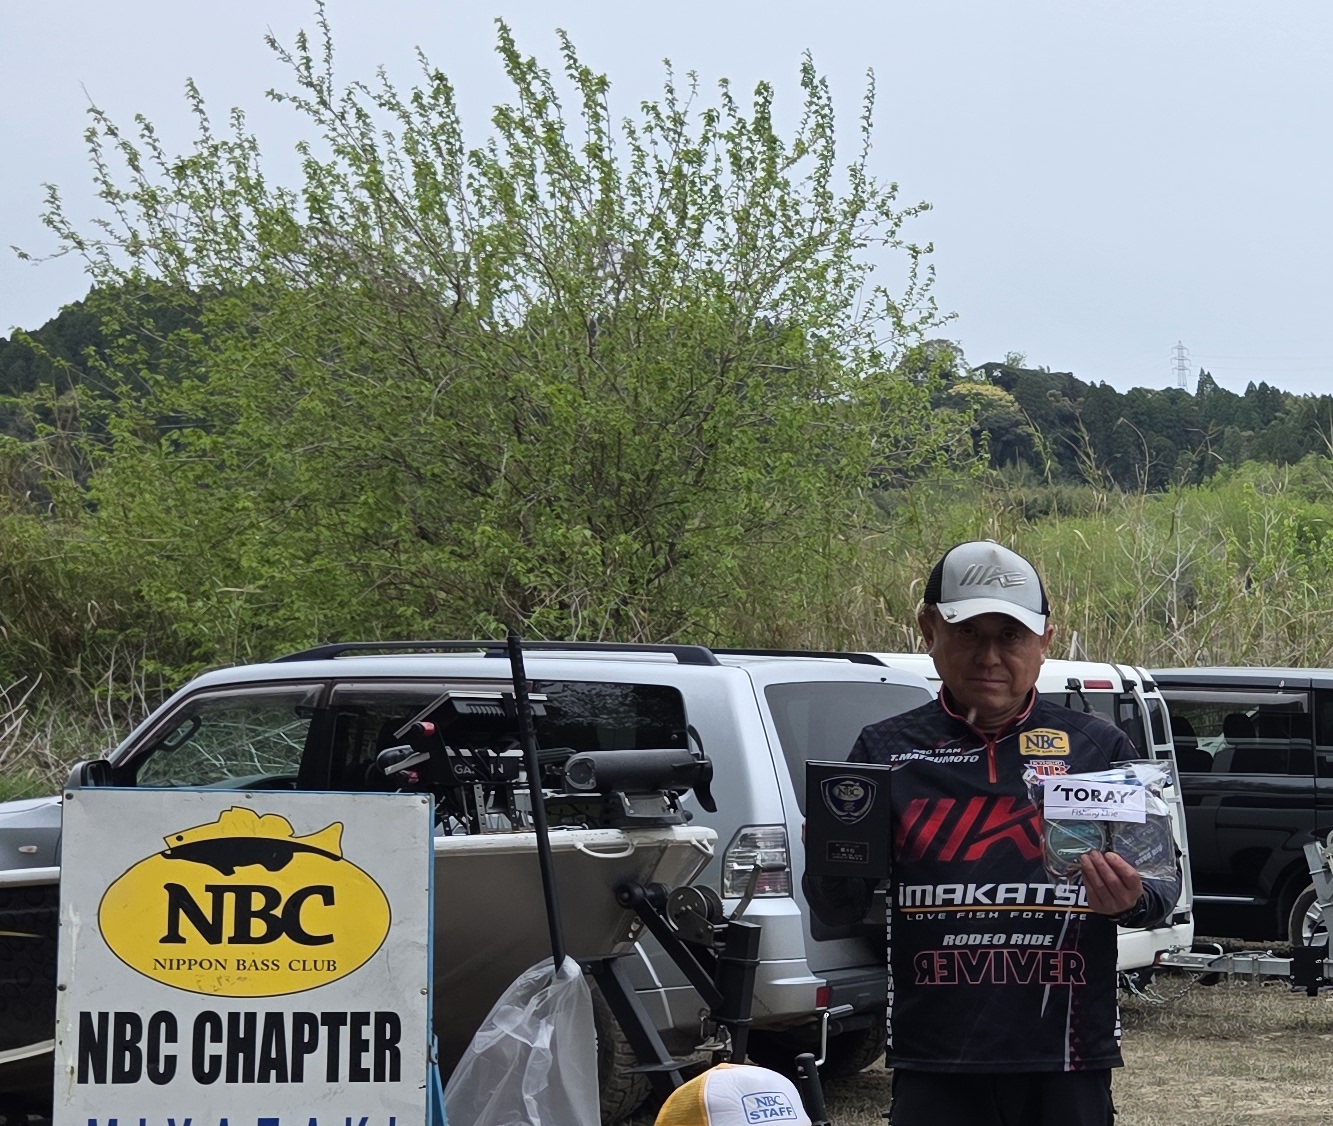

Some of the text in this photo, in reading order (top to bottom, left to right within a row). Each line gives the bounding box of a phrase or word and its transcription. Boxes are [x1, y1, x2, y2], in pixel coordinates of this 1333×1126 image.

[1024, 734, 1066, 749] NBC
[159, 883, 336, 946] NBC
[907, 913, 946, 921] LOVE
[1010, 911, 1044, 919] FOR
[943, 933, 1055, 946] RODEO RIDE
[152, 957, 338, 973] NIPPON BASS CLUB
[77, 1010, 402, 1085] NBC CHAPTER
[755, 1095, 784, 1108] NBC
[750, 1106, 794, 1121] STAFF
